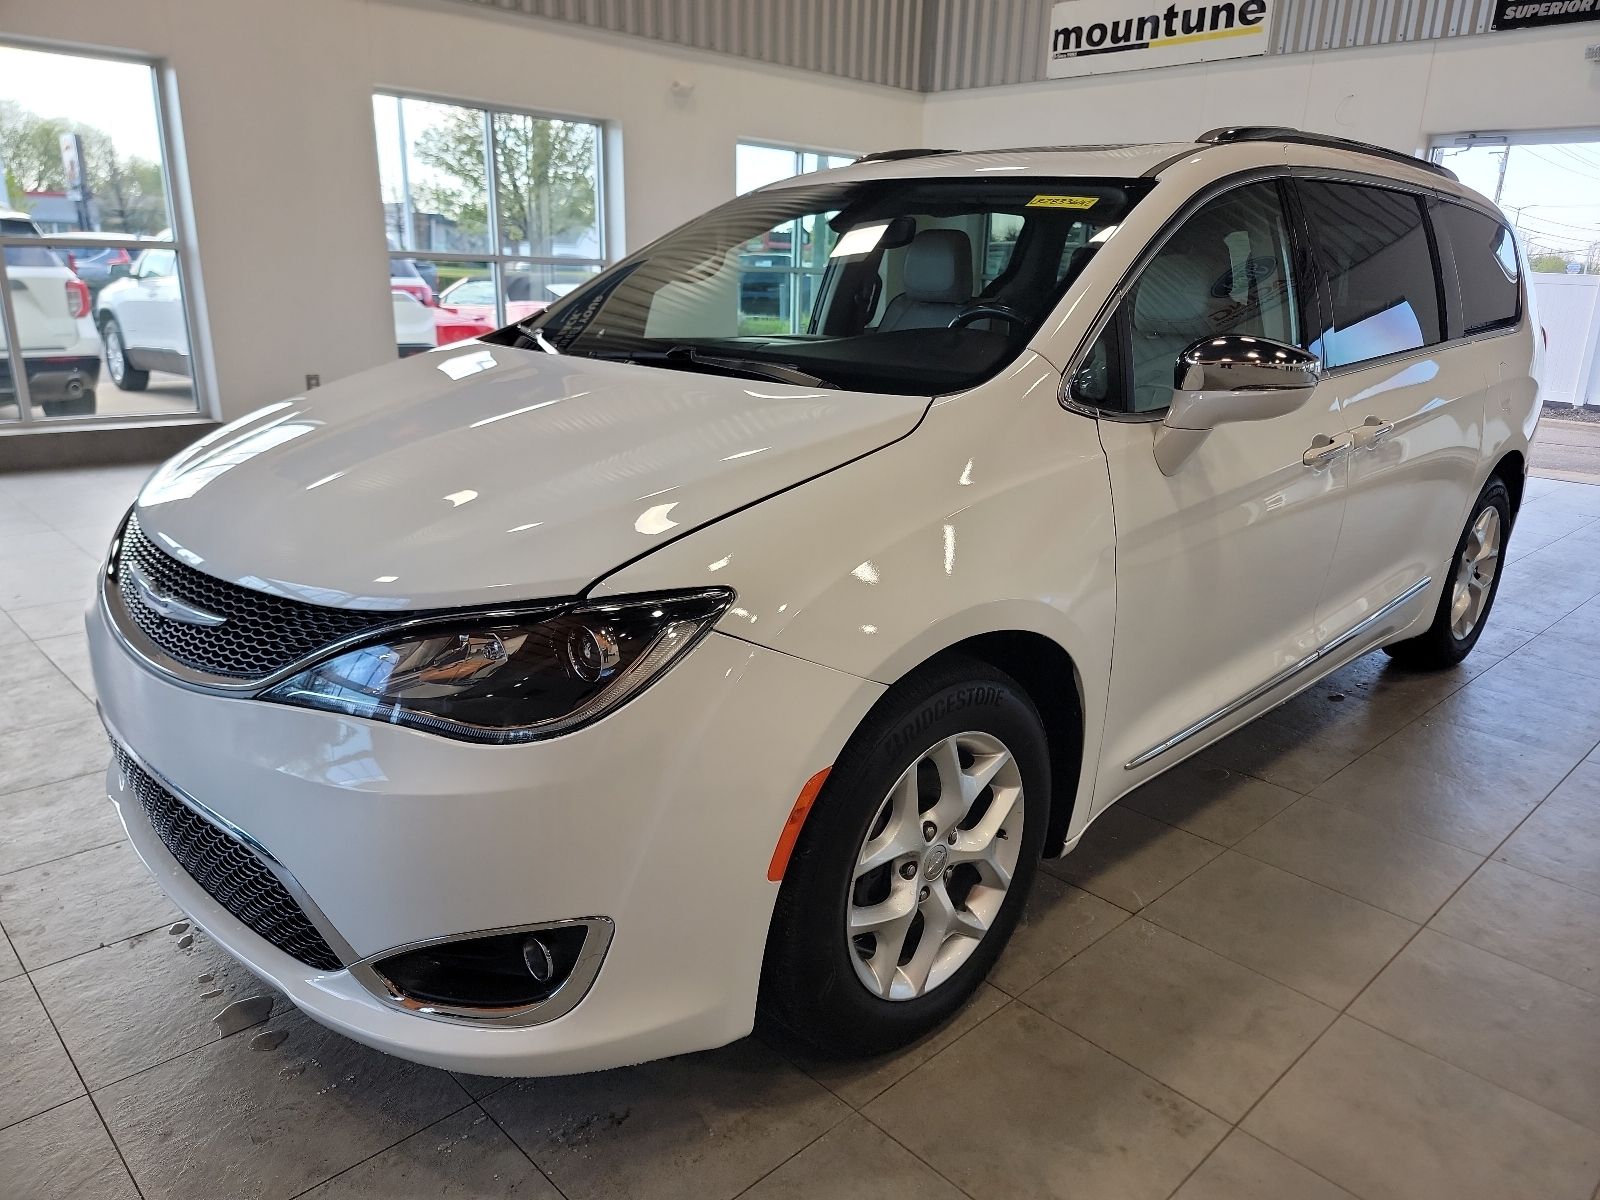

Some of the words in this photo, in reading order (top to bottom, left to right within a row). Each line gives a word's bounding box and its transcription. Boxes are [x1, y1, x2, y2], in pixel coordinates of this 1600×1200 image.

[1053, 0, 1267, 52] mountune
[1504, 0, 1594, 20] SUPERIOR
[885, 686, 1005, 756] BRIDGESTONE
